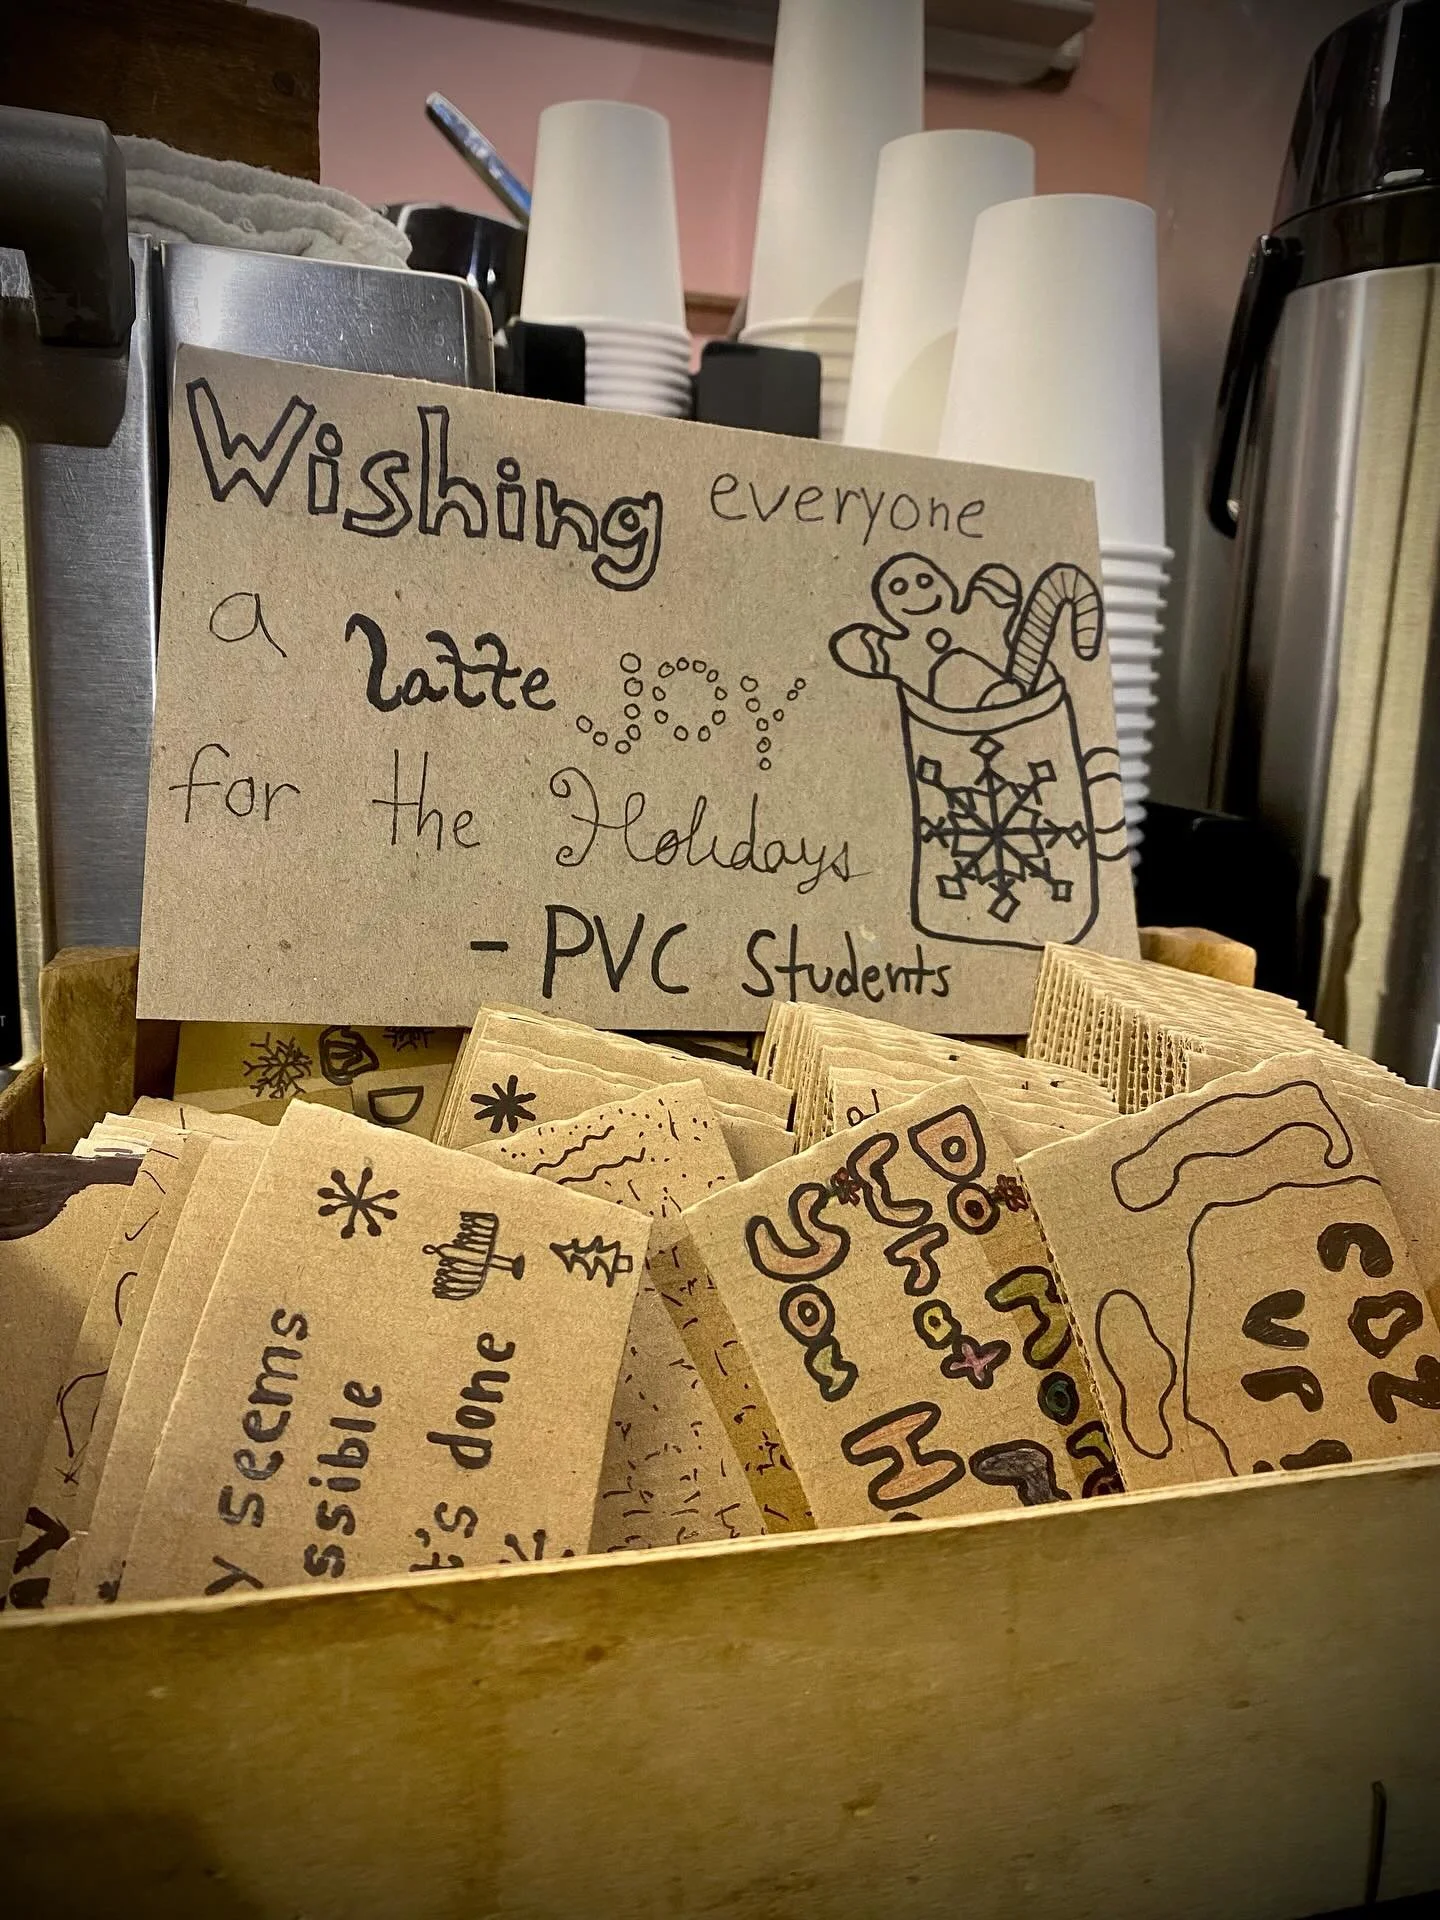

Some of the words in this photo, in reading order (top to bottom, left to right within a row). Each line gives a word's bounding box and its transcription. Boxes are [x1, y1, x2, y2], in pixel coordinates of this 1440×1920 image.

[185, 377, 664, 593] Wishing
[710, 472, 985, 546] everyone
[208, 591, 288, 658] a
[344, 612, 557, 712] latte
[576, 652, 806, 770] JOY
[169, 743, 301, 824] for
[372, 749, 480, 850] the
[550, 766, 873, 895] Holidays
[542, 905, 690, 999] PVC
[741, 924, 954, 1003] Students
[217, 1307, 309, 1529] seems
[426, 1331, 516, 1471] done
[841, 1401, 967, 1521] H
